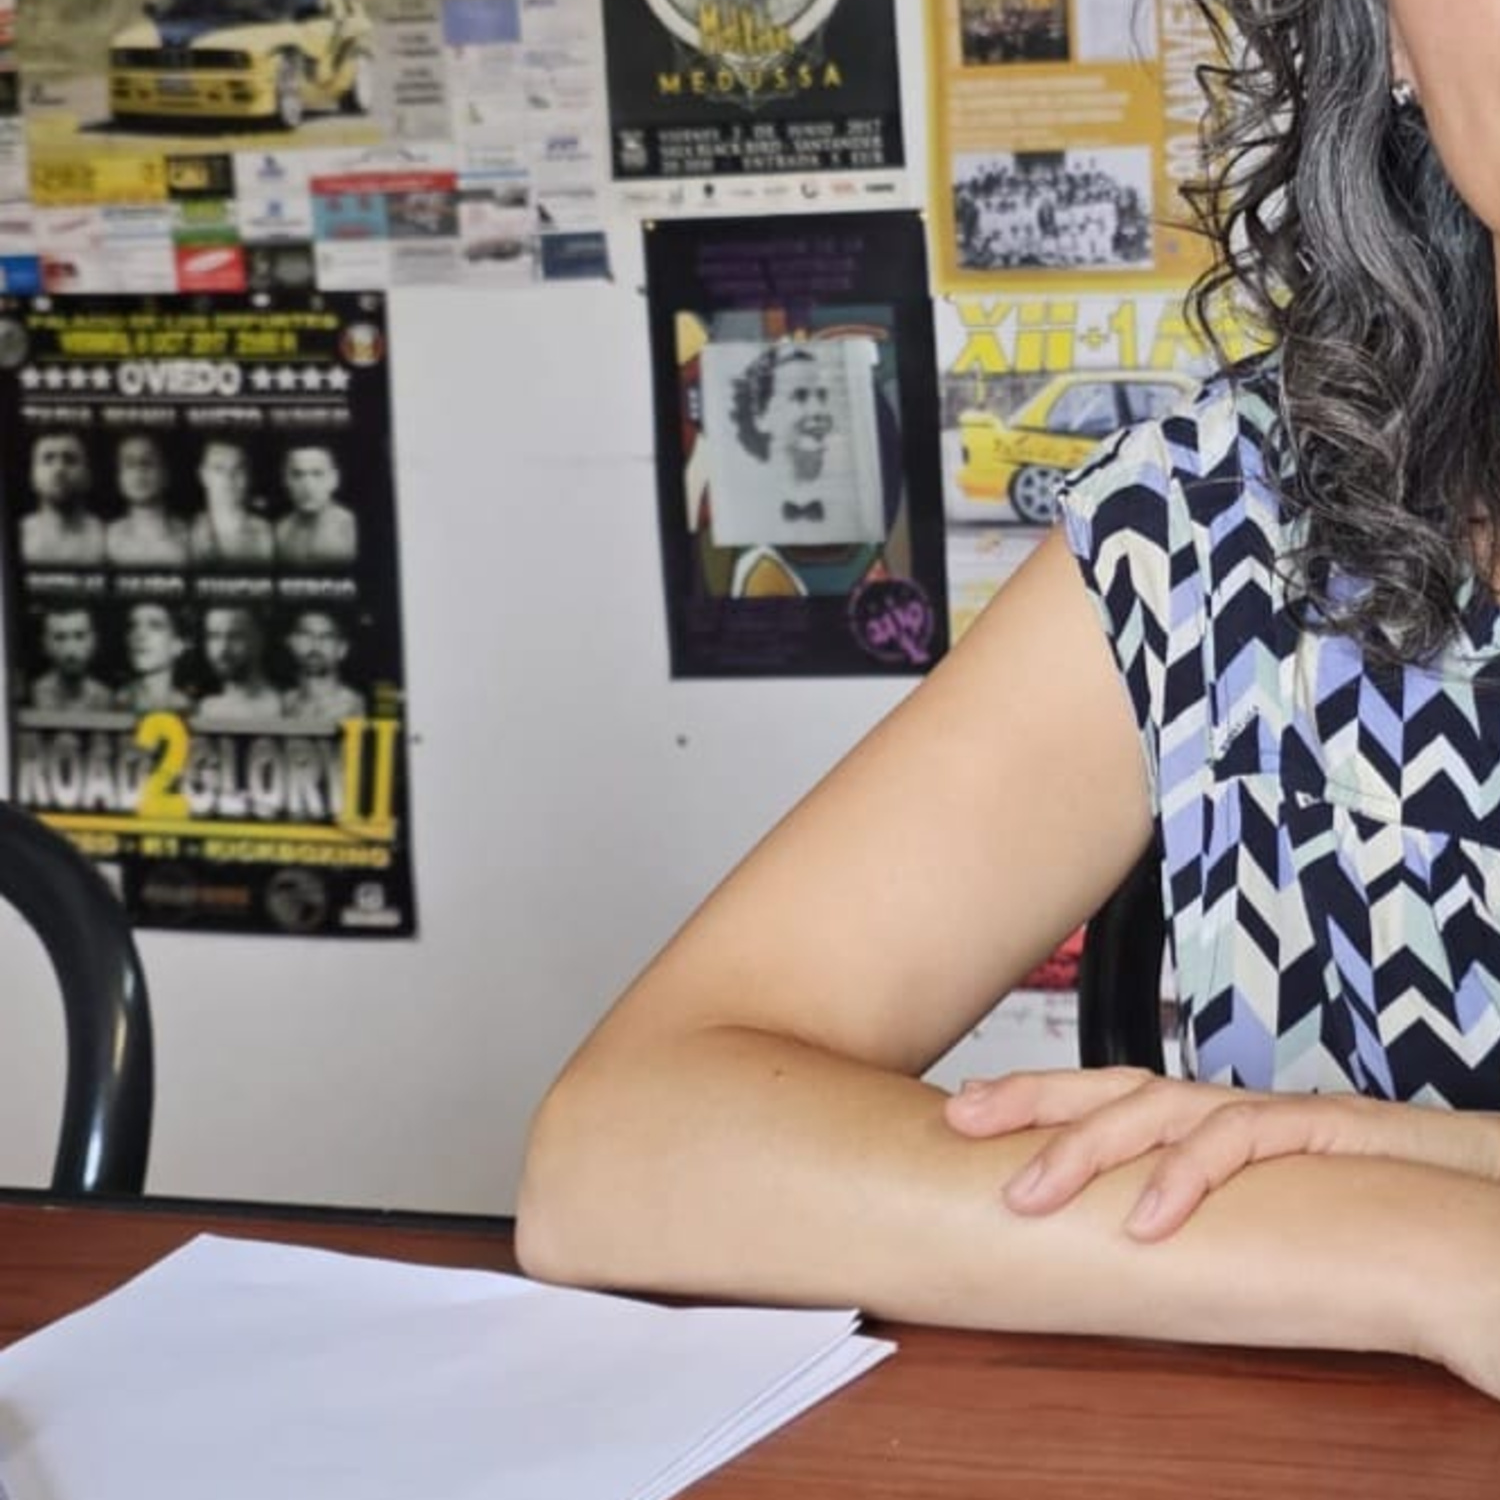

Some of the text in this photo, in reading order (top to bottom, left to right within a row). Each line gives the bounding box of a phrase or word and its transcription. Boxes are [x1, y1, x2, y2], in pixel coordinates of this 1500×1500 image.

[658, 61, 843, 95] MEDUSSA
[116, 360, 242, 397] OVIEDO
[18, 732, 146, 810] ROAD
[134, 711, 191, 819] 2
